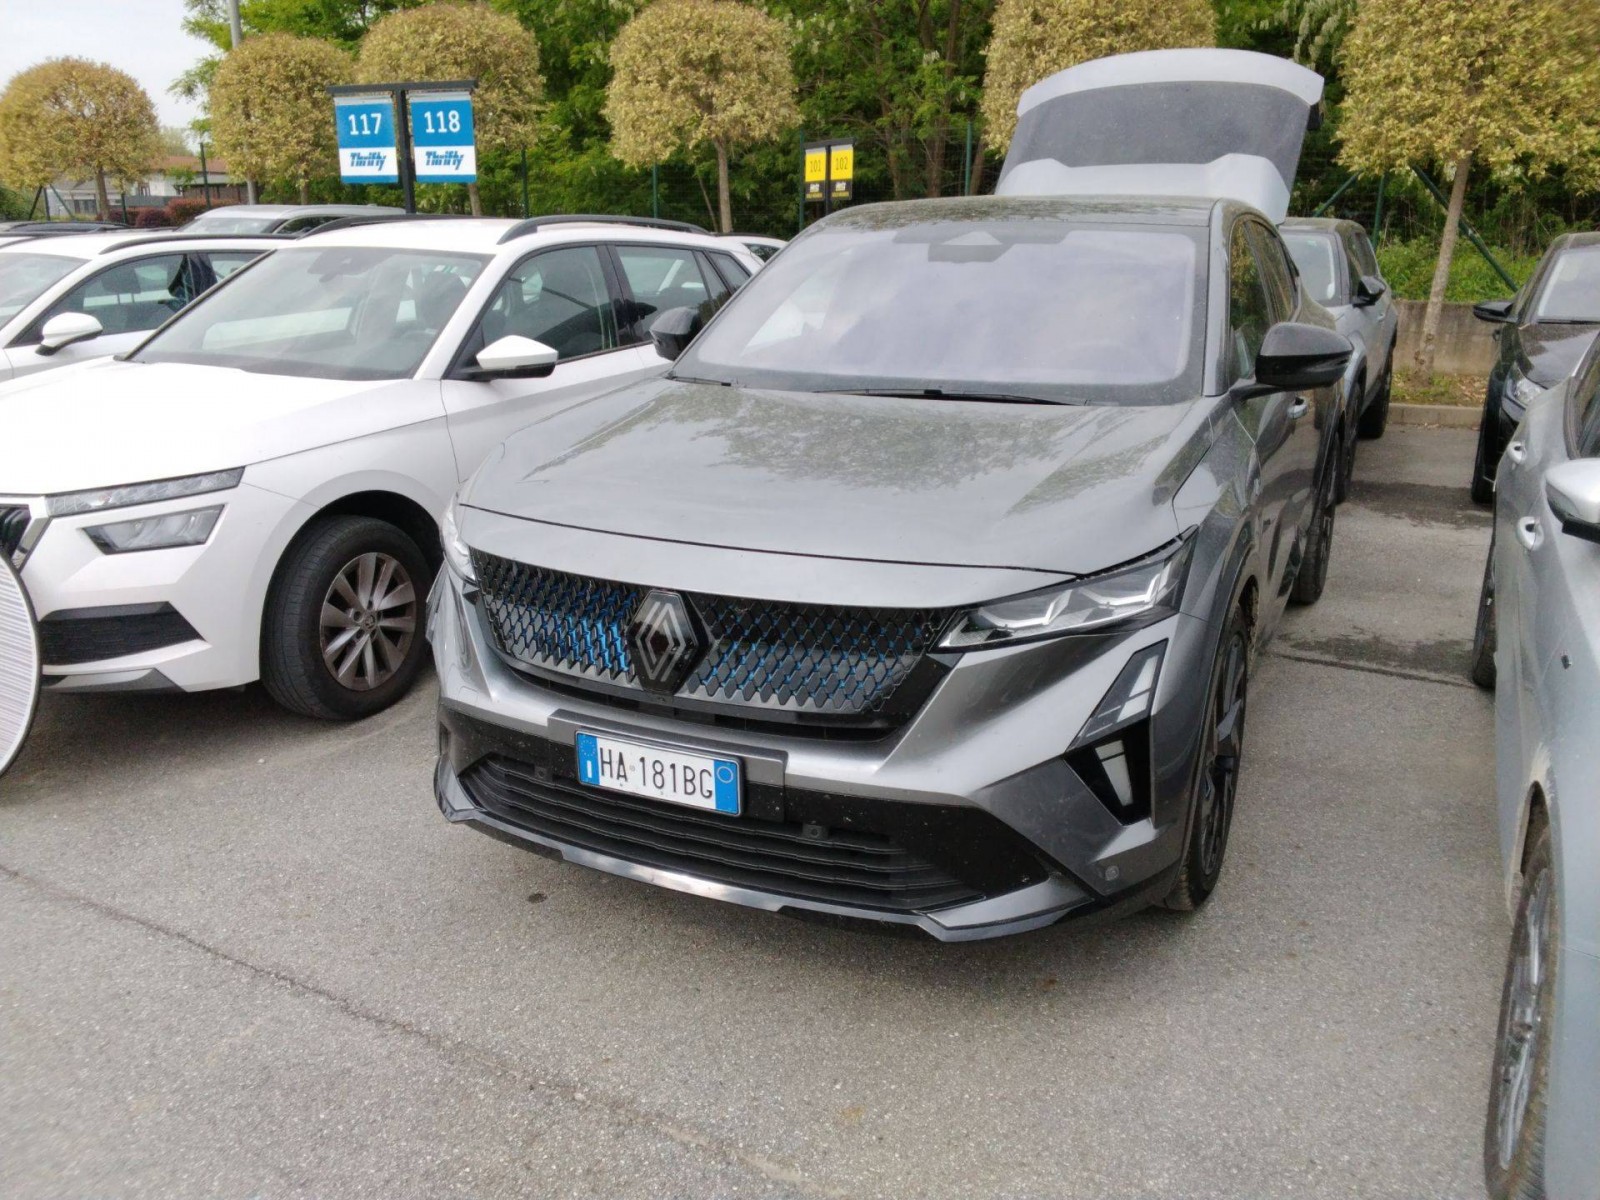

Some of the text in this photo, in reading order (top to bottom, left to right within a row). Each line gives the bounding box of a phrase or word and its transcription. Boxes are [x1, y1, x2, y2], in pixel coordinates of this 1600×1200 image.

[348, 113, 382, 135] 117
[424, 110, 461, 133] 118
[350, 152, 387, 171] Thrifty
[425, 150, 465, 170] Thrifty
[599, 747, 628, 782] HA
[639, 756, 713, 799] 181BG
